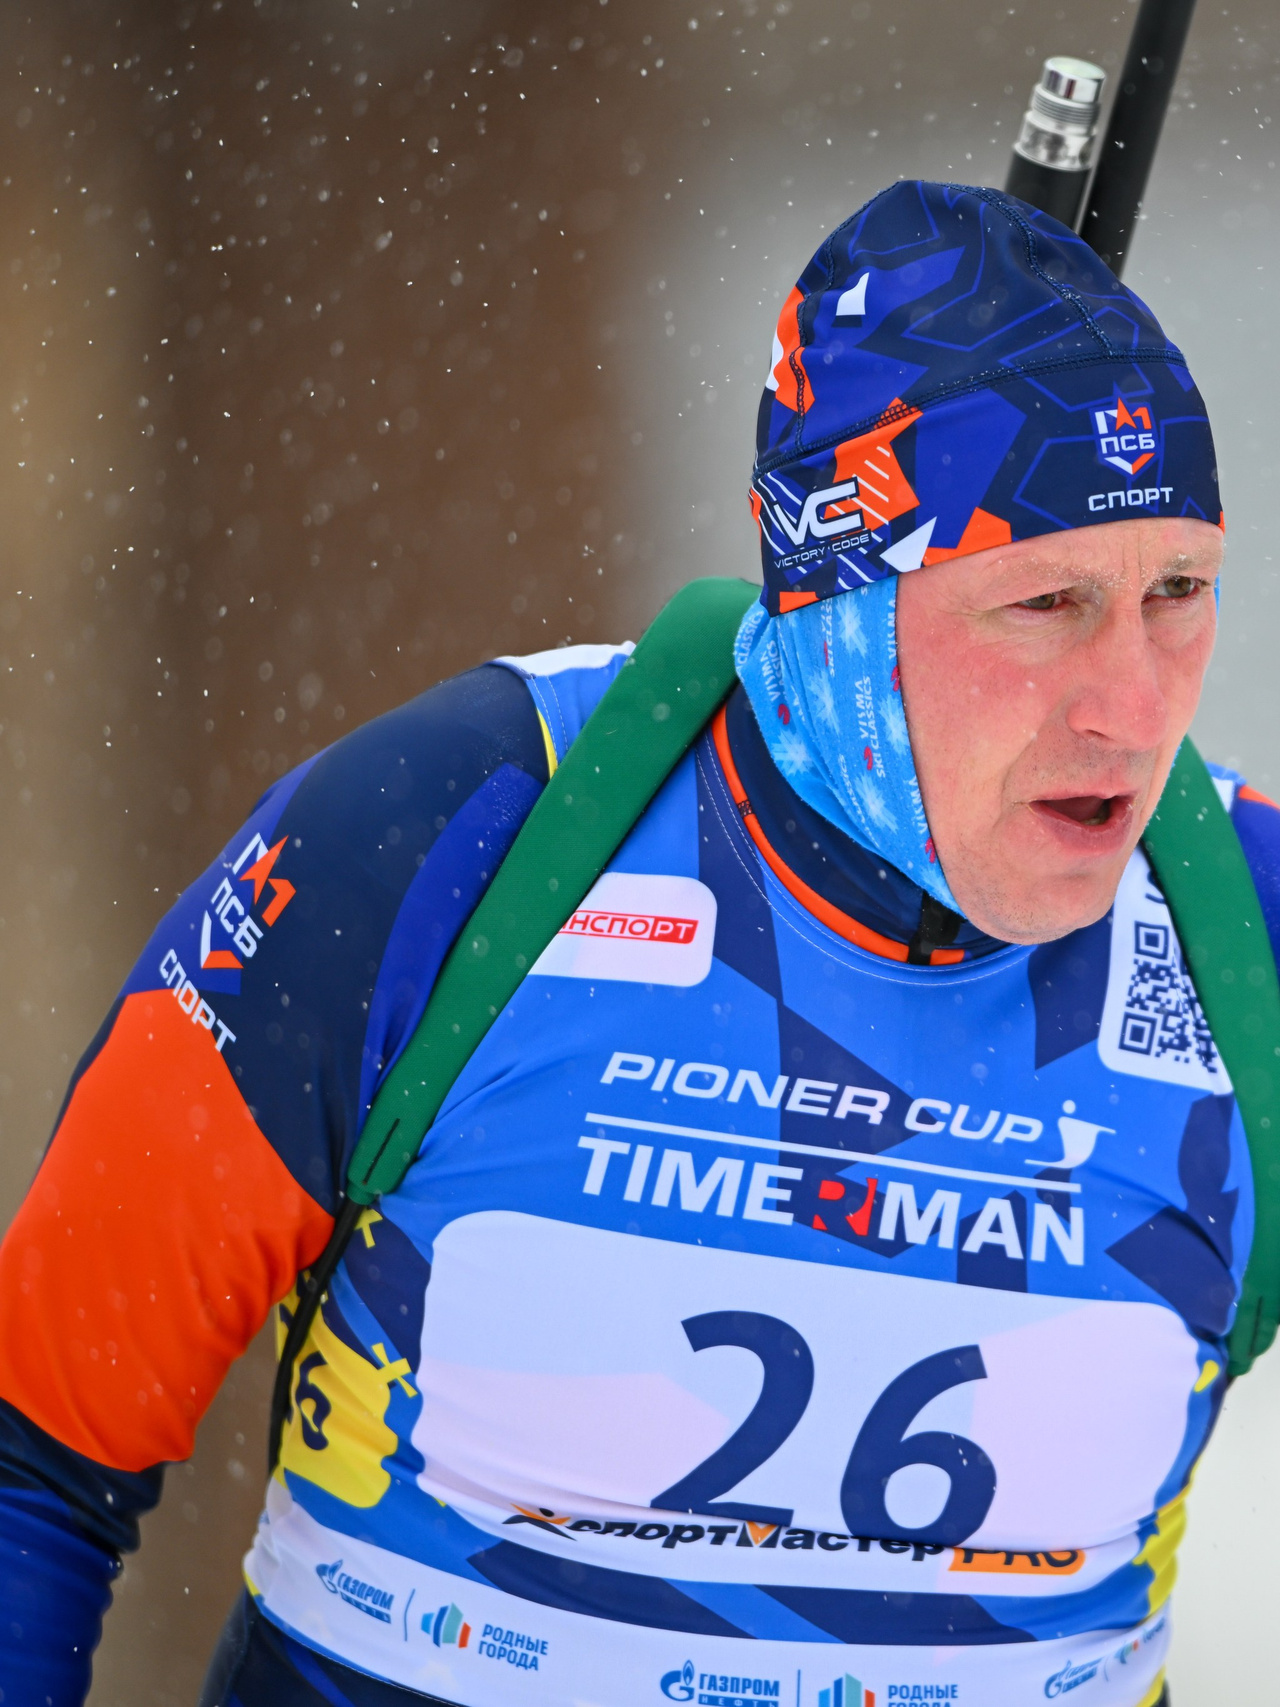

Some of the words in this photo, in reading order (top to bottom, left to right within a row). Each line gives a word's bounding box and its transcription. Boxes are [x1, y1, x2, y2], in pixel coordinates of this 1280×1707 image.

[1100, 433, 1155, 454] ПСБ
[773, 481, 861, 546] VC
[1088, 487, 1173, 511] СПОРТ
[774, 546, 825, 568] VICTORY
[831, 533, 869, 552] CODE
[760, 650, 781, 701] VISMA
[854, 680, 869, 739] VISMA
[863, 676, 879, 750] CLASSICS
[873, 752, 886, 778] SKI
[211, 877, 263, 958] ПСБ
[562, 914, 694, 940] НСПОРТ
[159, 949, 236, 1052] СПОРТ
[601, 1051, 892, 1126] PIONER
[903, 1097, 1043, 1145] CUP
[650, 1310, 997, 1547] 26
[337, 1573, 395, 1611] ГАЗПРОМ
[479, 1640, 539, 1671] ГОРОДА
[482, 1623, 549, 1656] РОДНЫЕ
[698, 1673, 780, 1698] ГАЗПРОМ
[888, 1684, 958, 1702] РОДНЫЕ
